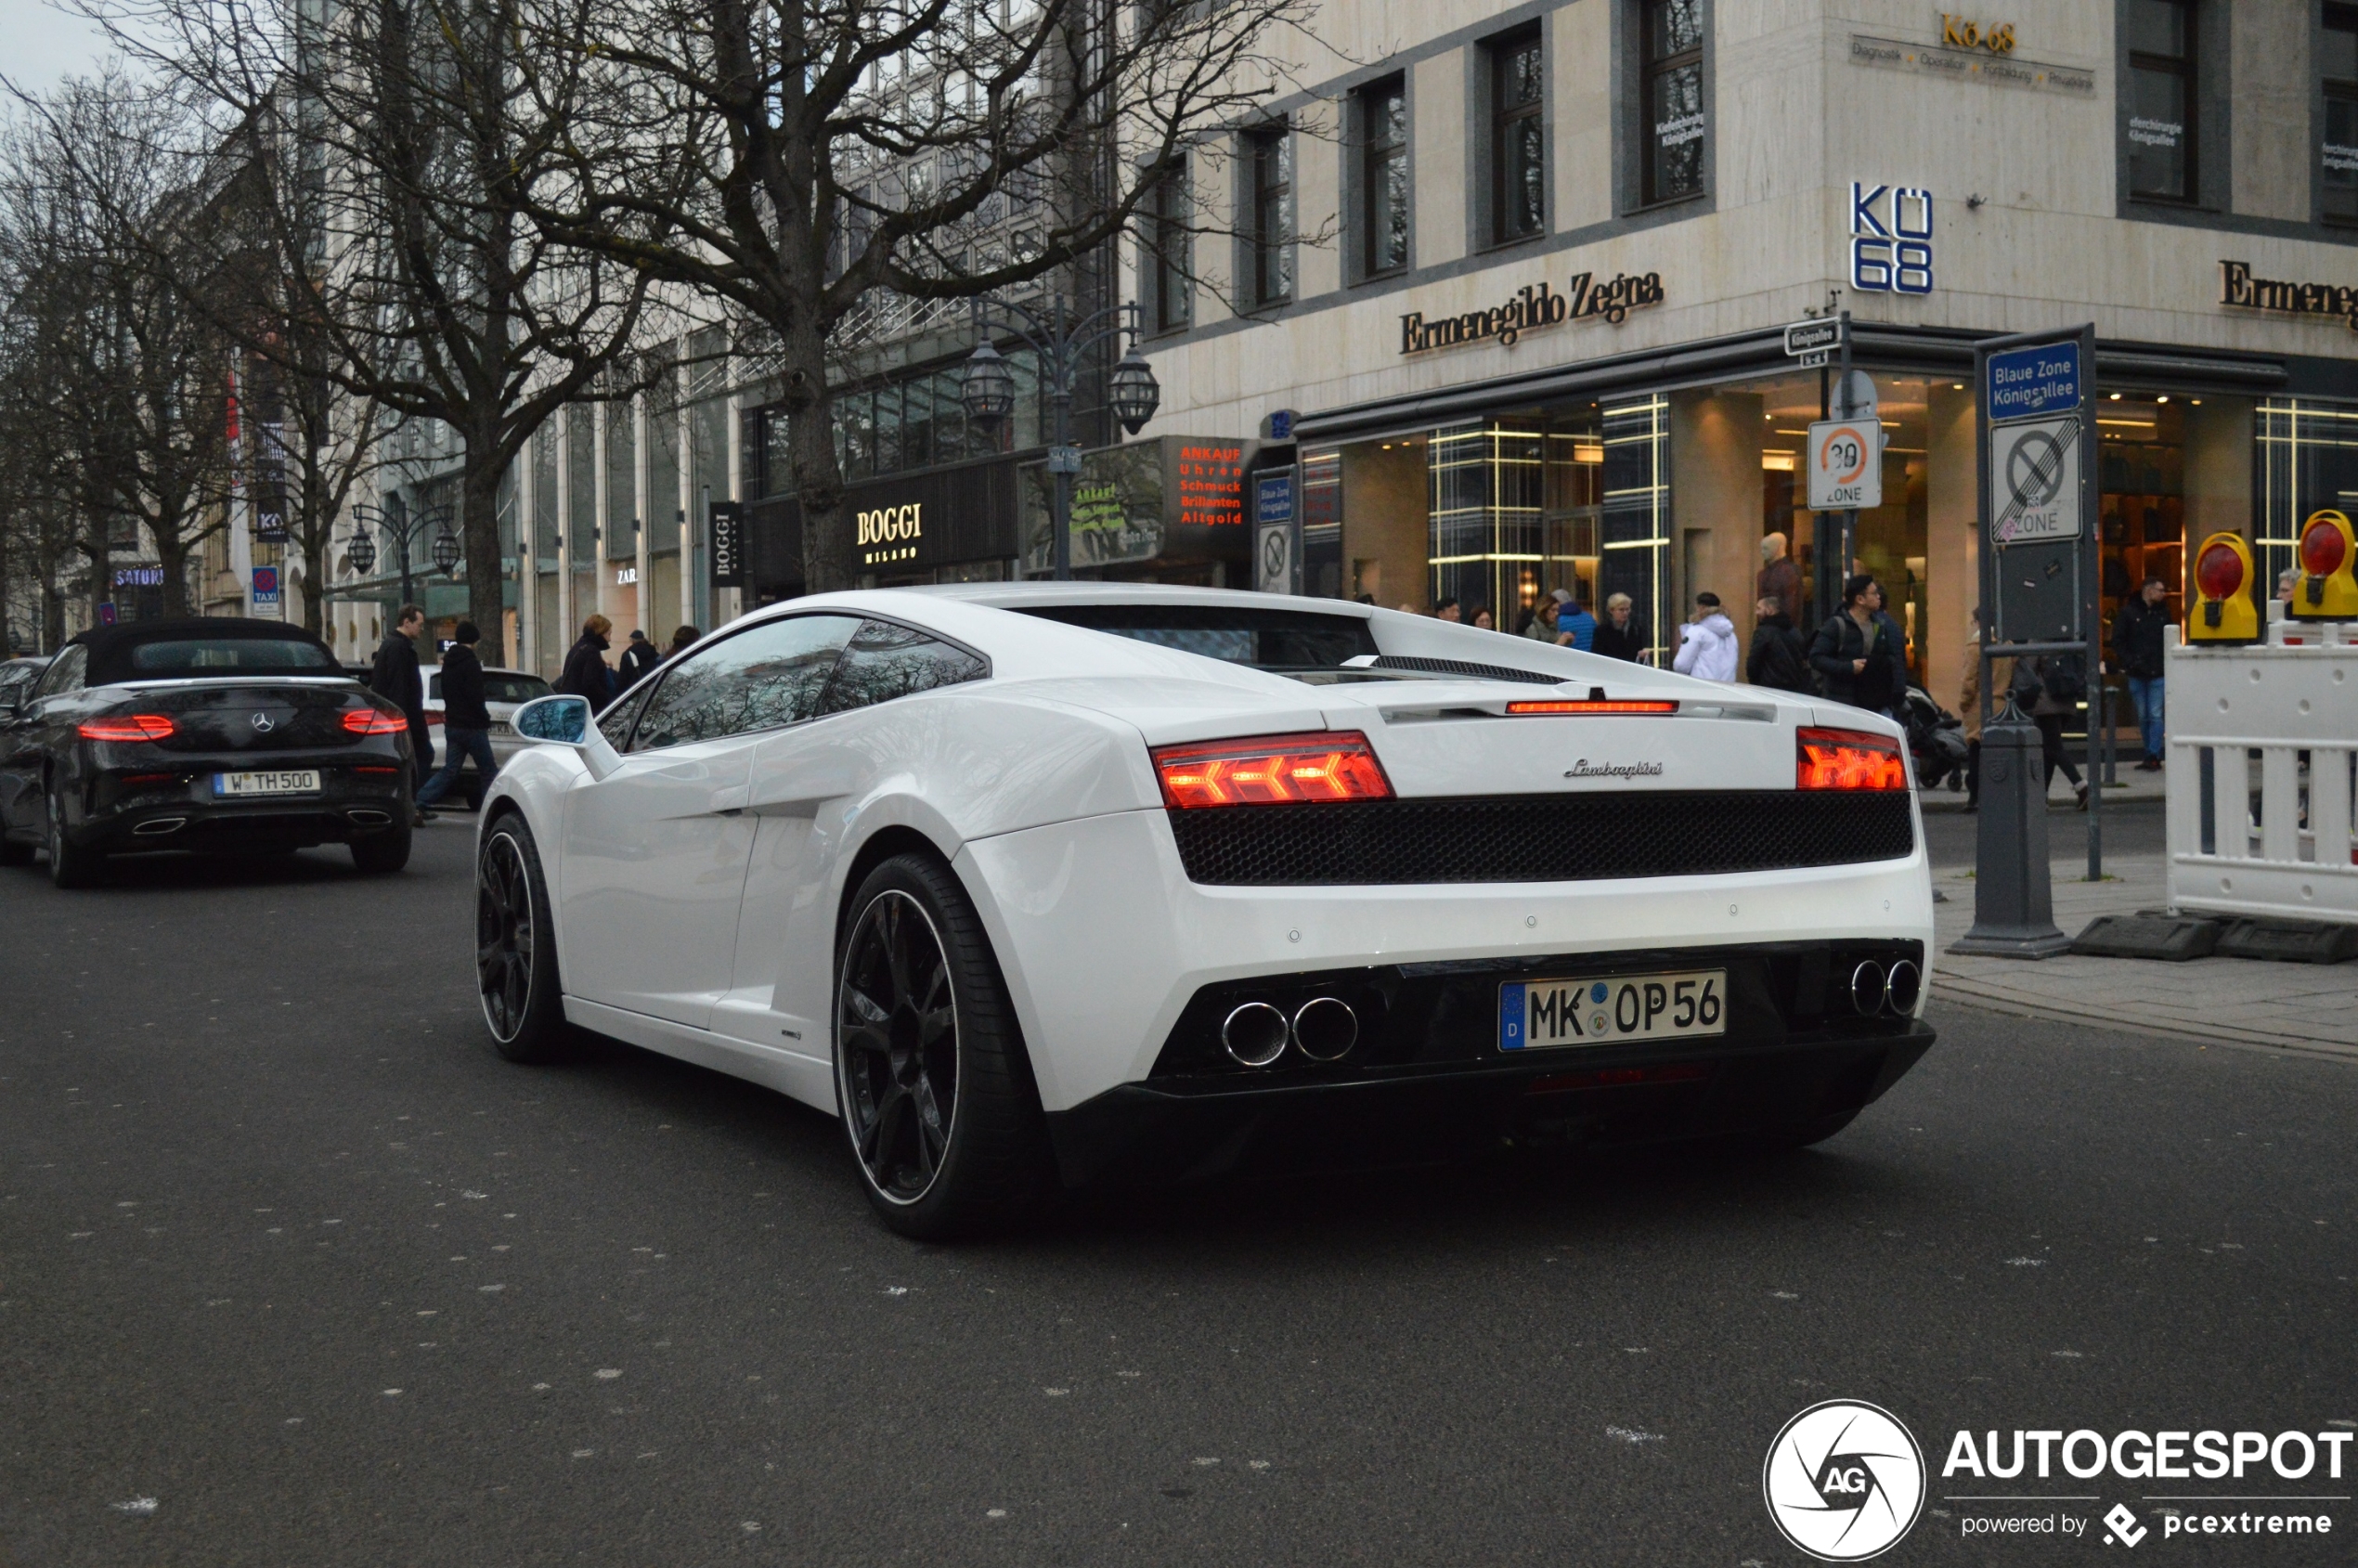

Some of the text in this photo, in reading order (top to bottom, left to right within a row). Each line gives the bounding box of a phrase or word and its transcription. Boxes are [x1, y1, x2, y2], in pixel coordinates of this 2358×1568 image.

[1942, 13, 2016, 53] Kö 68
[1852, 42, 1901, 61] Diagnostik
[1919, 53, 1966, 71] Operation
[1850, 182, 1933, 241] KÖ
[1850, 238, 1933, 294] 68
[1399, 272, 1665, 355] Ermenegildo Zegna
[1995, 360, 2071, 384] Blaue Zone
[1994, 381, 2074, 406] Königsallee
[1181, 447, 1240, 461] ANKAUF
[1180, 463, 1242, 477] Uhren
[1180, 480, 1241, 492] Schmuck
[1181, 496, 1241, 508] Brillanten
[857, 503, 922, 546] BOGGI
[1181, 511, 1242, 526] Altgold
[2015, 512, 2058, 534] ZONE
[716, 513, 731, 576] BOGGI
[865, 546, 916, 564] MILANO
[617, 568, 639, 585] ZAR
[254, 592, 278, 603] TAXI
[1562, 758, 1664, 780] Lamborghini
[231, 775, 242, 791] W
[254, 773, 278, 790] TH
[281, 772, 313, 789] 500
[1508, 1023, 1518, 1038] D
[1530, 988, 1585, 1039] MK
